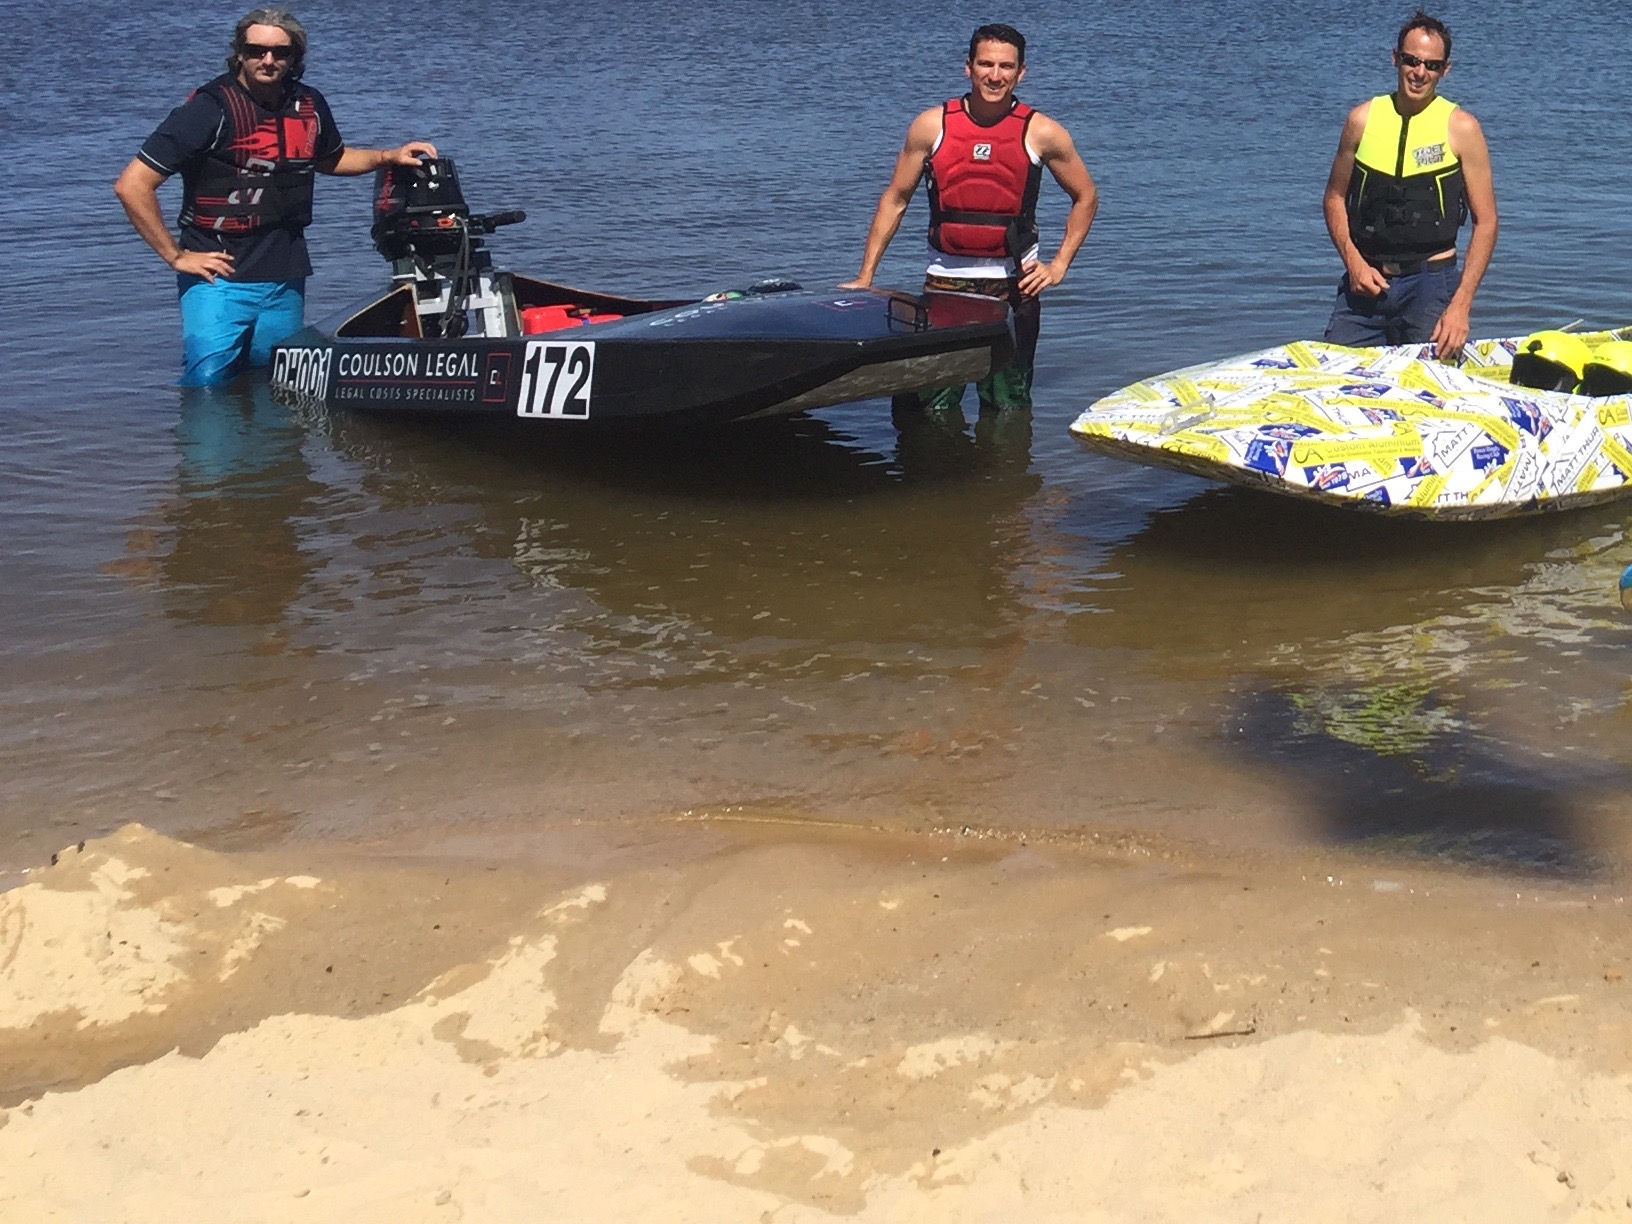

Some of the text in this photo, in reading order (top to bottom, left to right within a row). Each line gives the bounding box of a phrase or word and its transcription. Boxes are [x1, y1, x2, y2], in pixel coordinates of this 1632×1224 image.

[339, 353, 479, 377] COULSON LEGAL
[335, 386, 476, 402] LEGAL COSTS SPECIALISTS
[524, 346, 591, 416] 172
[1325, 443, 1366, 453] Custom
[1368, 439, 1420, 448] Aluminium
[1440, 427, 1468, 458] MATT
[1556, 455, 1579, 487] MATT
[1579, 426, 1600, 456] THUR
